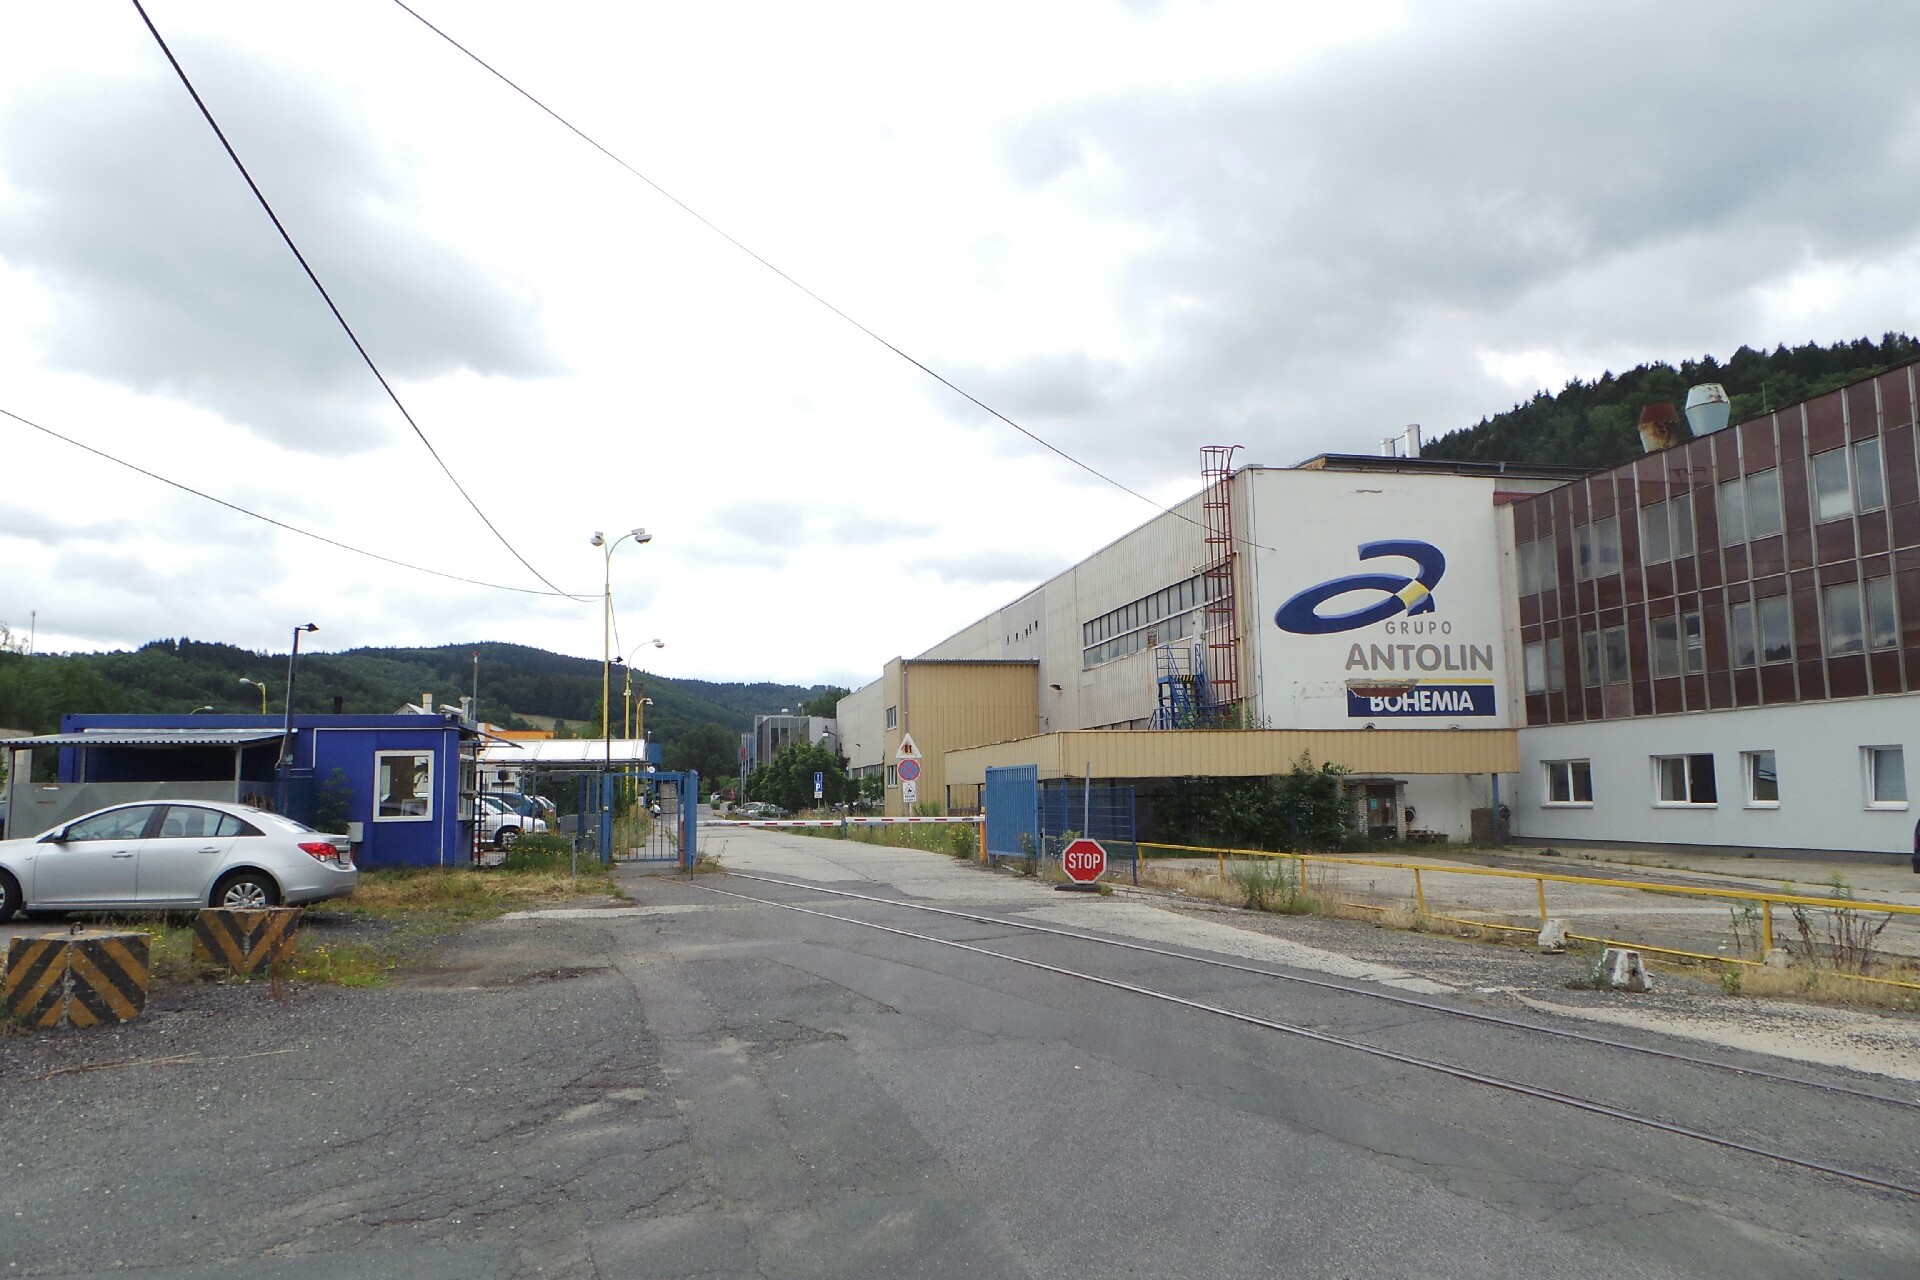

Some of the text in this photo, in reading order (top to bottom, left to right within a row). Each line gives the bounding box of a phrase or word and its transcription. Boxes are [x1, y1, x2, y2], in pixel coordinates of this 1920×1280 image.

[1385, 621, 1451, 634] GRUPO
[1345, 643, 1493, 671] ANTOLIN
[1370, 691, 1474, 712] BOHEMIA
[816, 783, 821, 791] P
[1068, 853, 1101, 869] STOP
